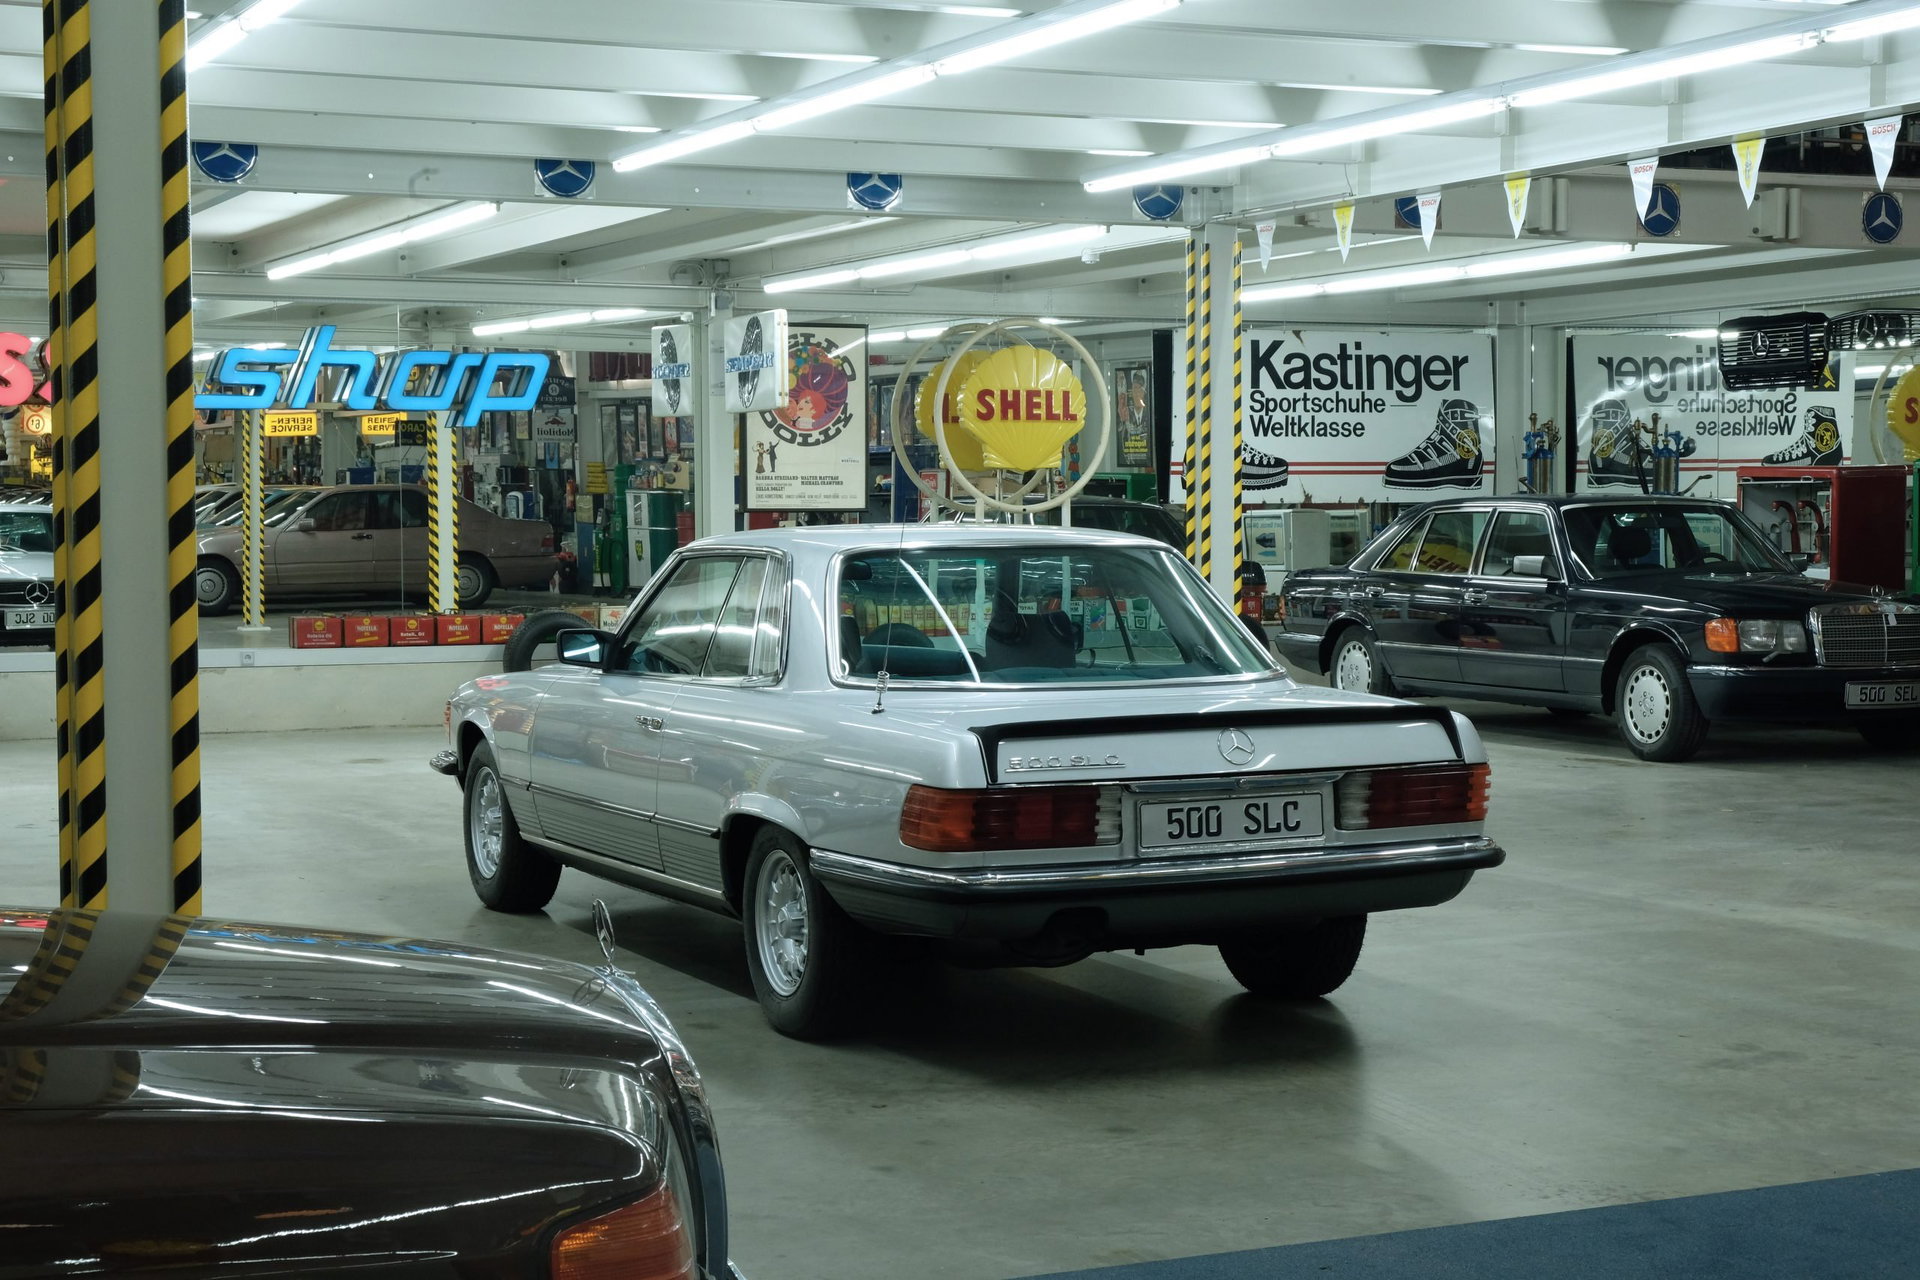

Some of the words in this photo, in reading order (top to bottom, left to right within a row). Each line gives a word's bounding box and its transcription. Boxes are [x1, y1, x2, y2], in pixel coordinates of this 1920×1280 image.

[1872, 124, 1896, 135] BOSCH
[1633, 164, 1654, 174] BOSCH
[1259, 225, 1273, 233] BOSCH
[194, 325, 550, 428] shop
[1250, 339, 1469, 403] Kastinger
[976, 388, 1078, 421] SHELL
[1250, 389, 1386, 416] Sportschuhe
[1249, 415, 1366, 438] Weltklasse
[1859, 686, 1886, 702] 500
[1894, 685, 1918, 702] SEL
[1008, 755, 1062, 769] 500
[1069, 754, 1120, 767] SLC
[1167, 805, 1223, 840] 500
[1243, 800, 1301, 836] SLC
